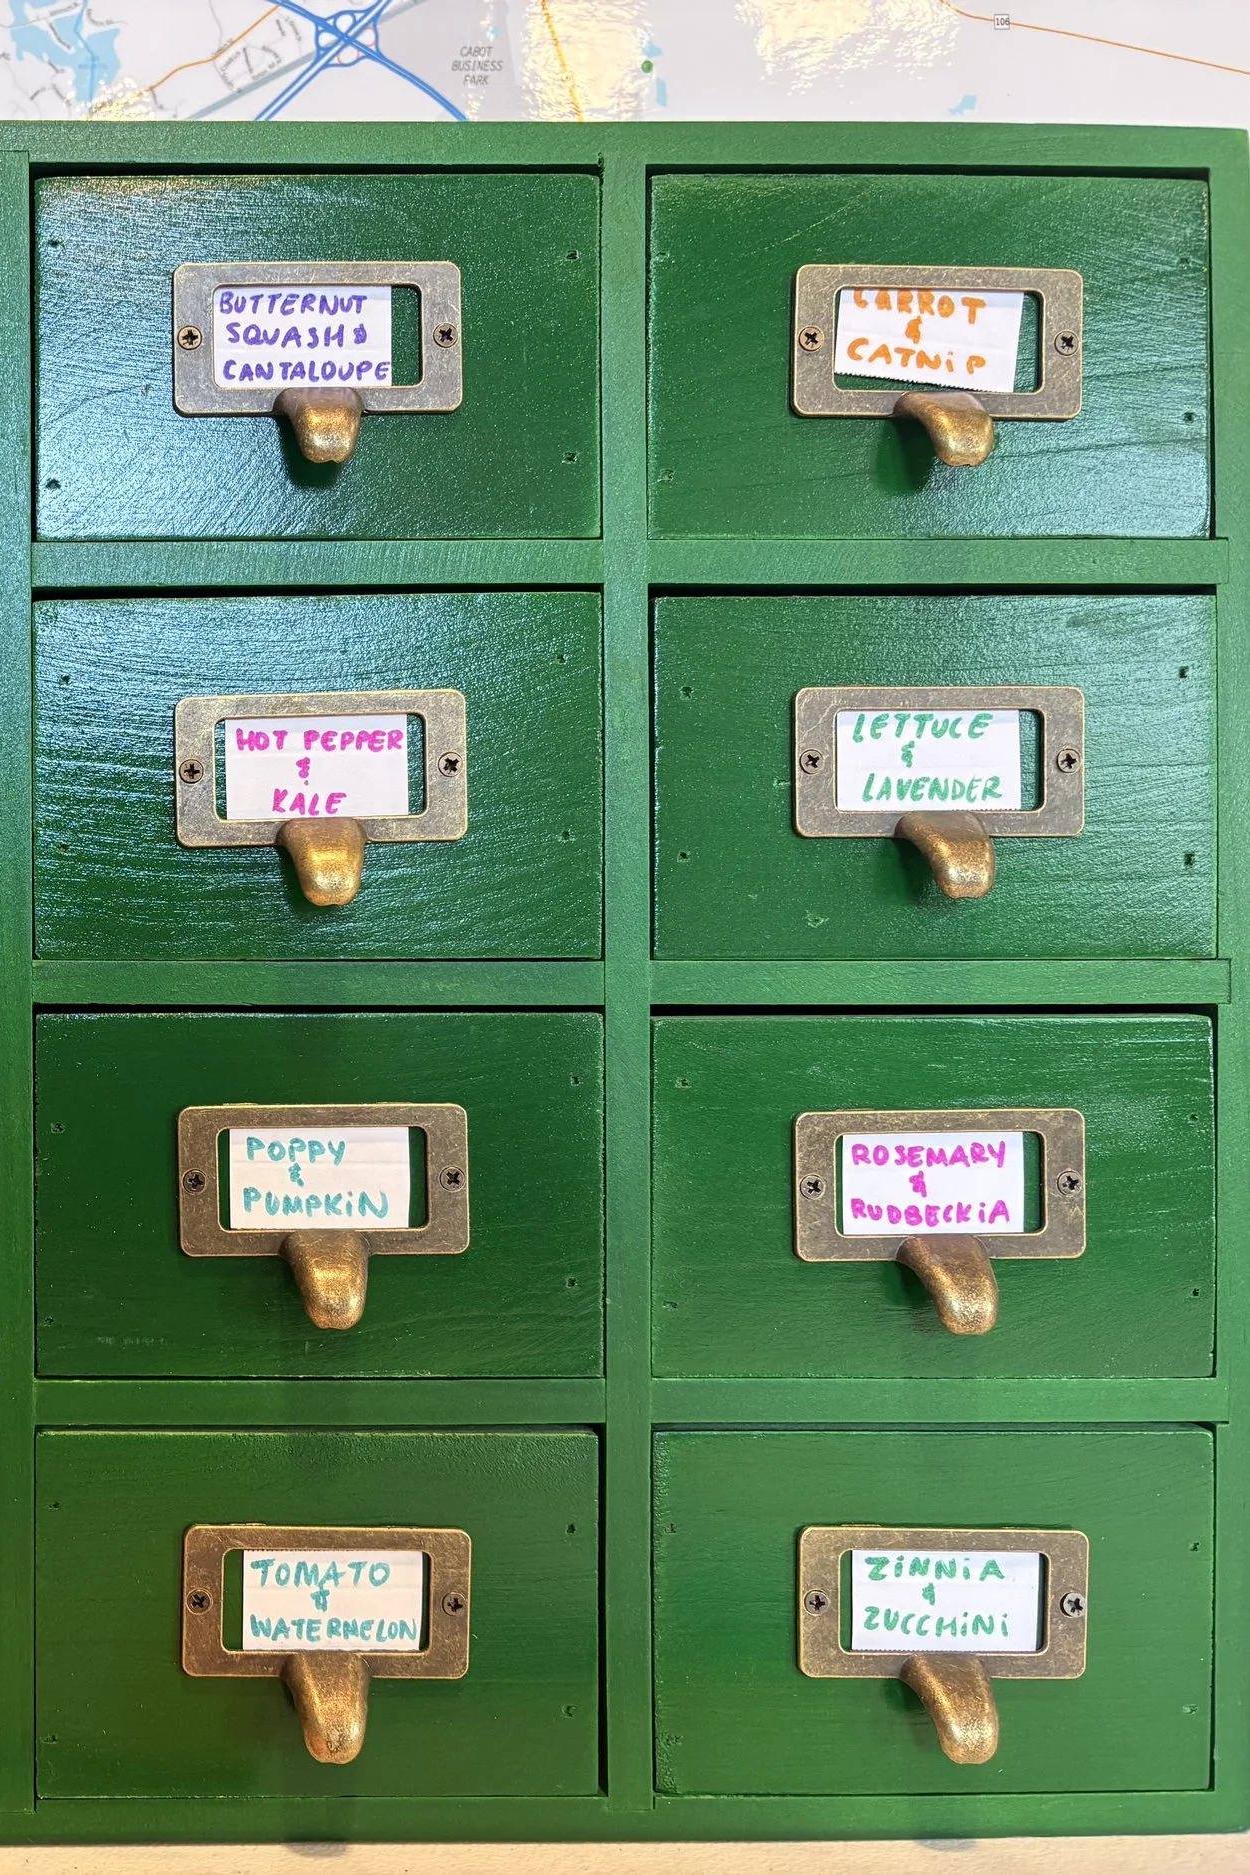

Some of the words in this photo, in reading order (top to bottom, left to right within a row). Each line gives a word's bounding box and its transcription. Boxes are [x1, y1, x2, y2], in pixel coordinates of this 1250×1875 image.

[996, 17, 1010, 26] 106
[460, 46, 494, 58] CABOT
[451, 60, 504, 72] BUSINESS
[463, 74, 490, 86] PARK
[219, 291, 368, 316] BUTTERNUT
[853, 288, 987, 325] CARROT
[226, 322, 345, 348] SQUASH
[223, 360, 390, 382] CANTALOUPE
[236, 728, 288, 752] HOT
[303, 729, 404, 753] PEPPER
[852, 713, 994, 743] LETTUCE
[861, 773, 1003, 803] LAVENDER
[272, 788, 347, 816] KALE
[246, 1136, 346, 1166] POPPY
[851, 1141, 1006, 1168] ROSEMARY
[250, 1559, 391, 1587] TOMATO
[250, 1614, 417, 1643] WATERMELON
